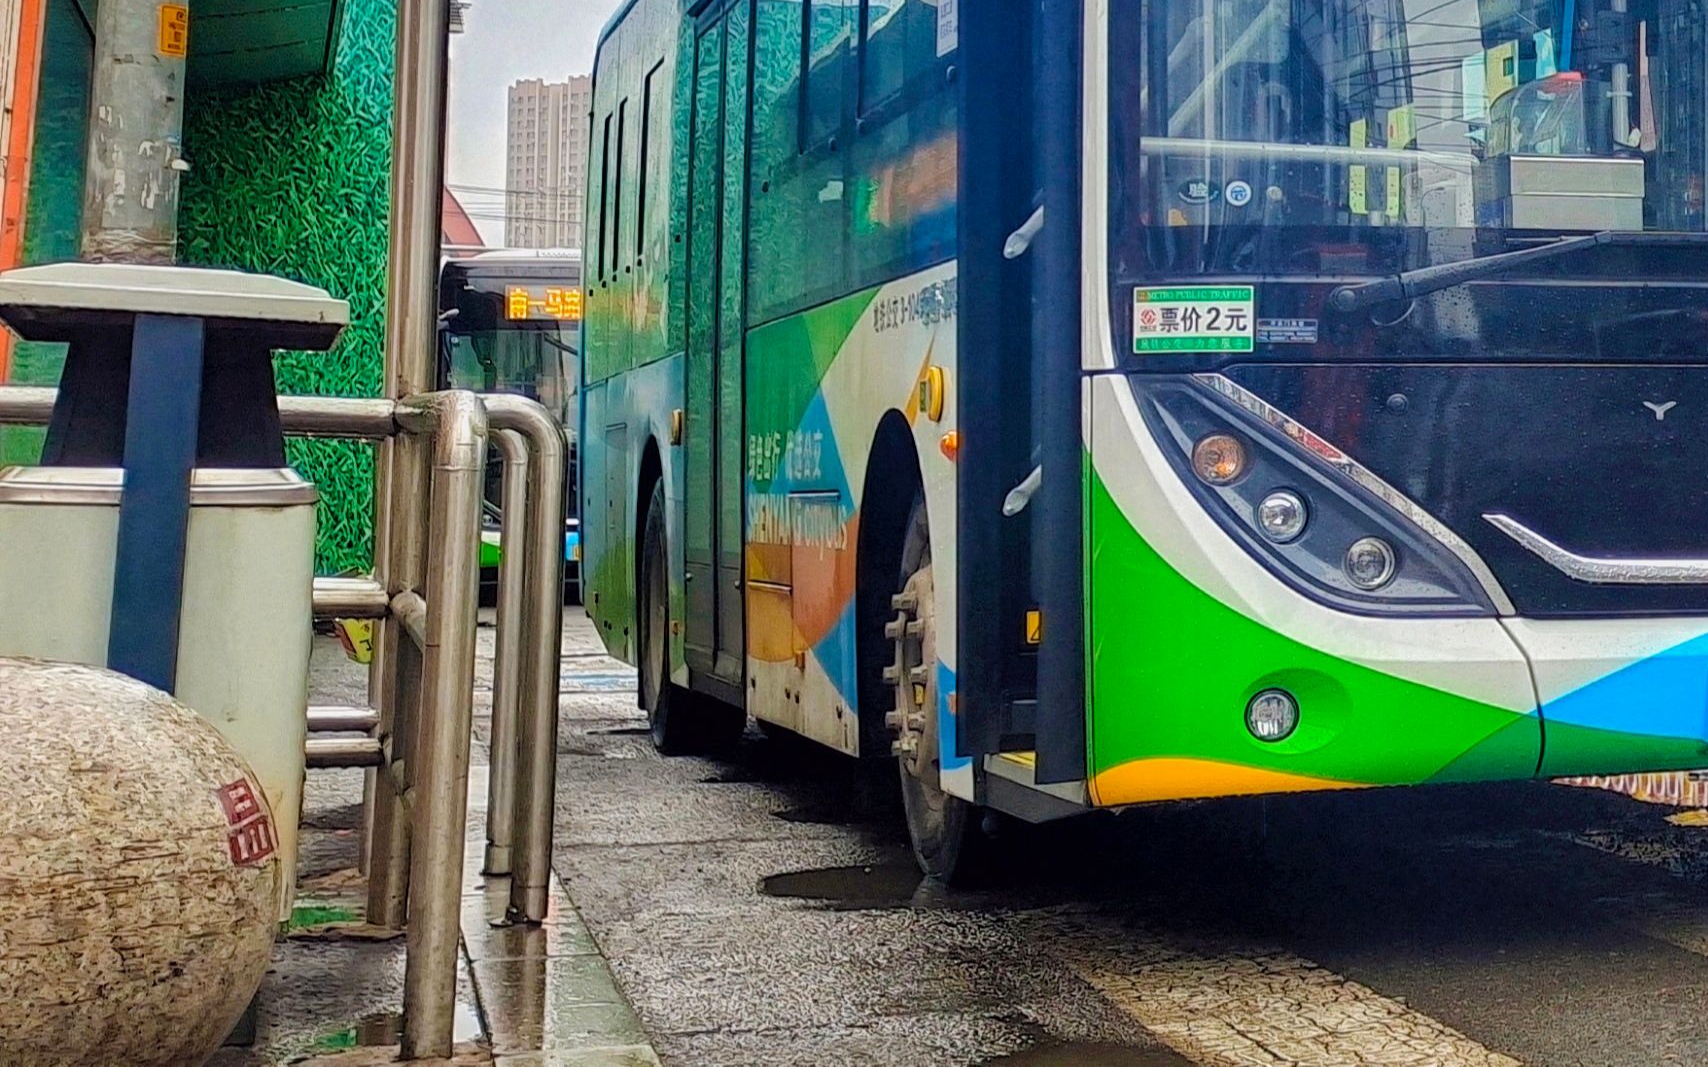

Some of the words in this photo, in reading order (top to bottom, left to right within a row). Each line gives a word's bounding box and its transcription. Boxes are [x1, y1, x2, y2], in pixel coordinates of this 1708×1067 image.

[1176, 290, 1208, 300] PUBLIC
[1209, 289, 1249, 300] TRAFFIC
[1159, 306, 1248, 333] 票价2元
